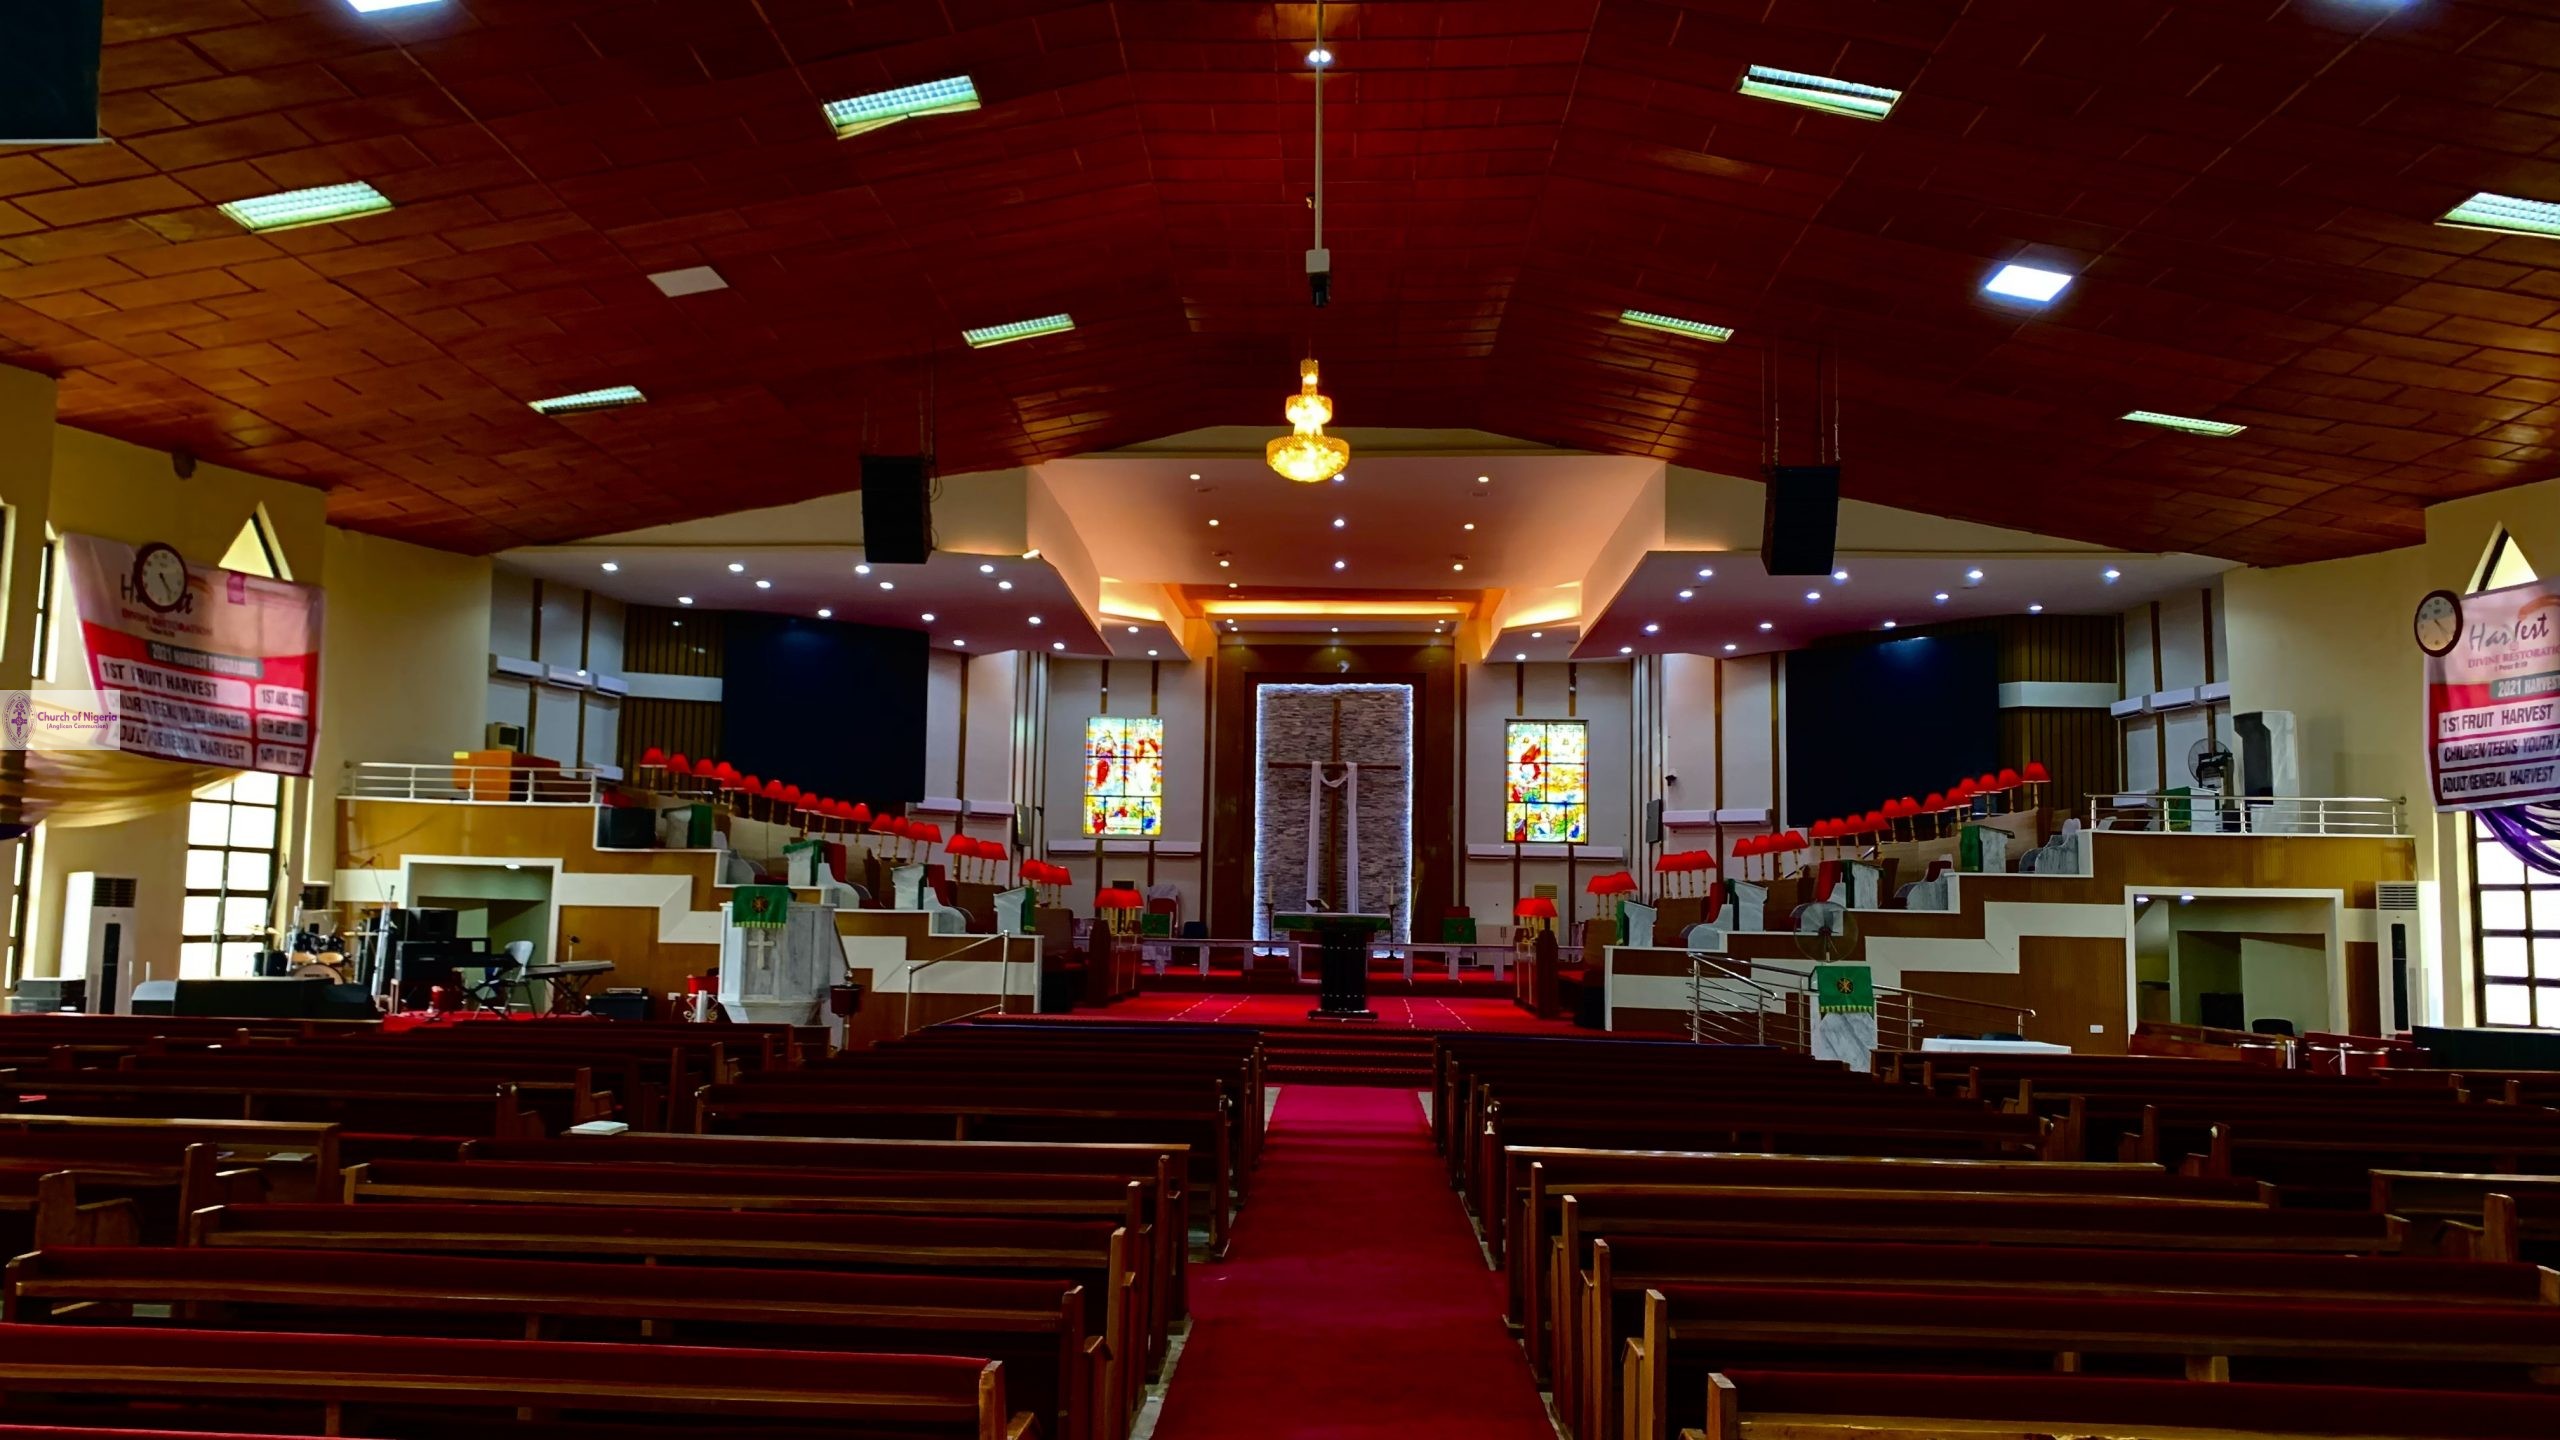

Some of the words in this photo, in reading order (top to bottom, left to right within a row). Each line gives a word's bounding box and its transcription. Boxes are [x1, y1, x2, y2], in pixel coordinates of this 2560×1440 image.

[2468, 612, 2550, 652] Harvest
[2467, 654, 2501, 669] DIVINE
[103, 661, 126, 680] 1ST
[166, 673, 218, 698] HARVEST
[2497, 678, 2521, 698] 2021
[2442, 716, 2460, 733] 1ST
[2462, 712, 2495, 730] FRUIT
[2501, 704, 2554, 726] HARVEST
[200, 739, 245, 760] HARVEST
[2523, 733, 2555, 753] YOUTH
[2509, 765, 2555, 786] HARVEST
